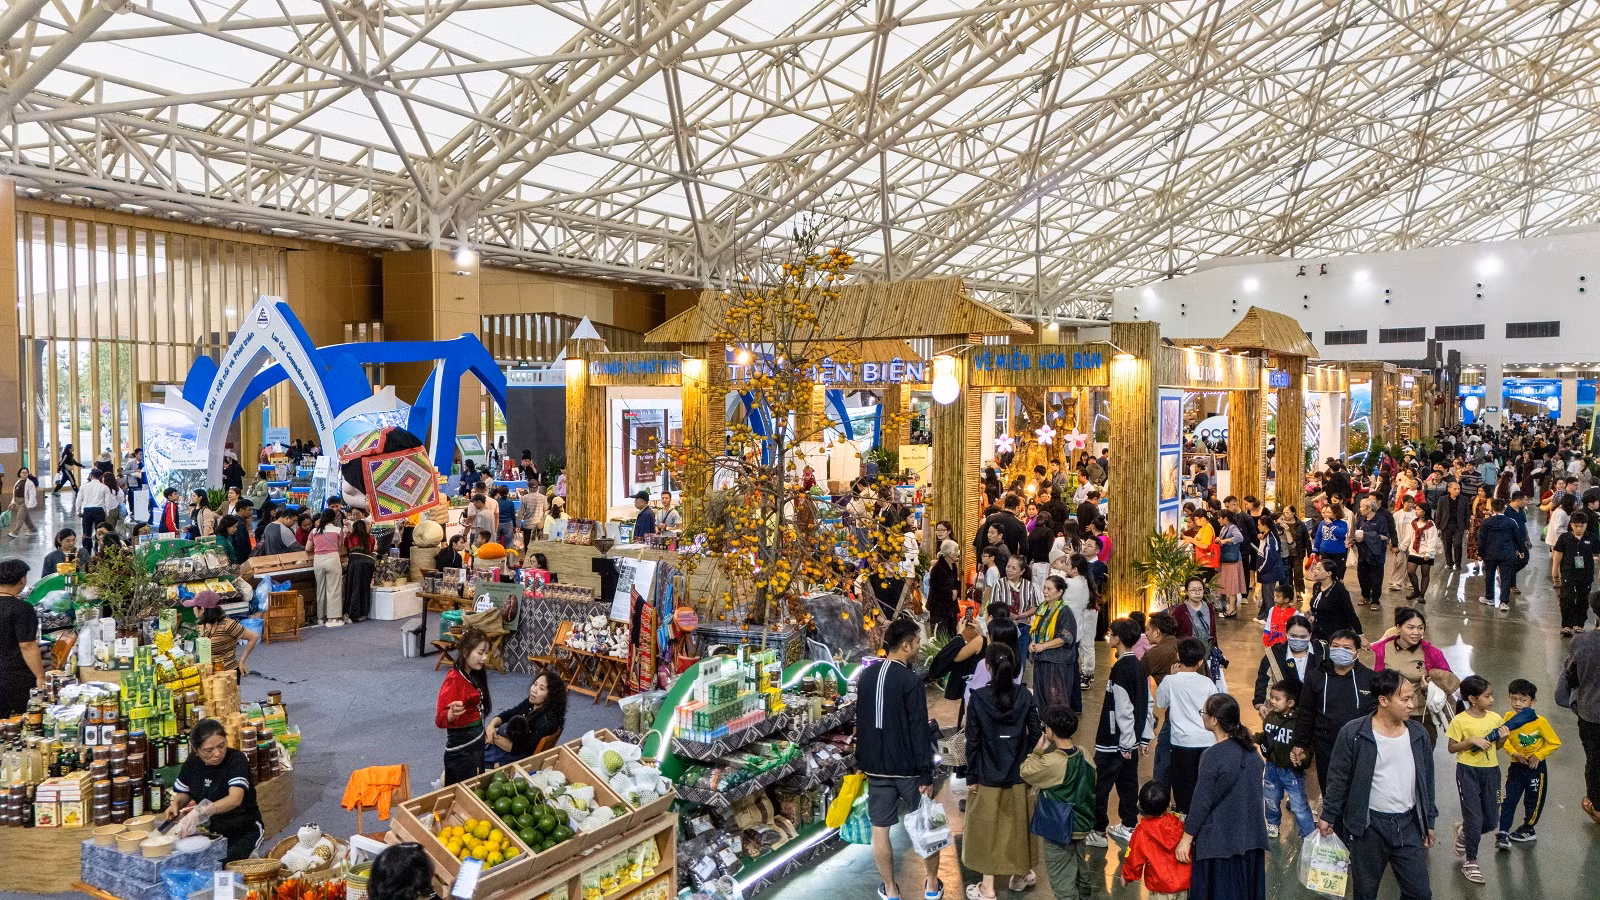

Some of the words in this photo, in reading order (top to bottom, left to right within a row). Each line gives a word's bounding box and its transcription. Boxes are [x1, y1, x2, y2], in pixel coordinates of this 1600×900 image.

[863, 356, 924, 383] BIÊN
[974, 347, 991, 371] VỀ
[995, 347, 1031, 371] MIỀN
[1038, 352, 1067, 370] HOA
[1073, 351, 1103, 369] BAN
[209, 397, 217, 411] Cai
[286, 351, 305, 382] Connection
[302, 380, 311, 392] and
[308, 390, 326, 432] Development
